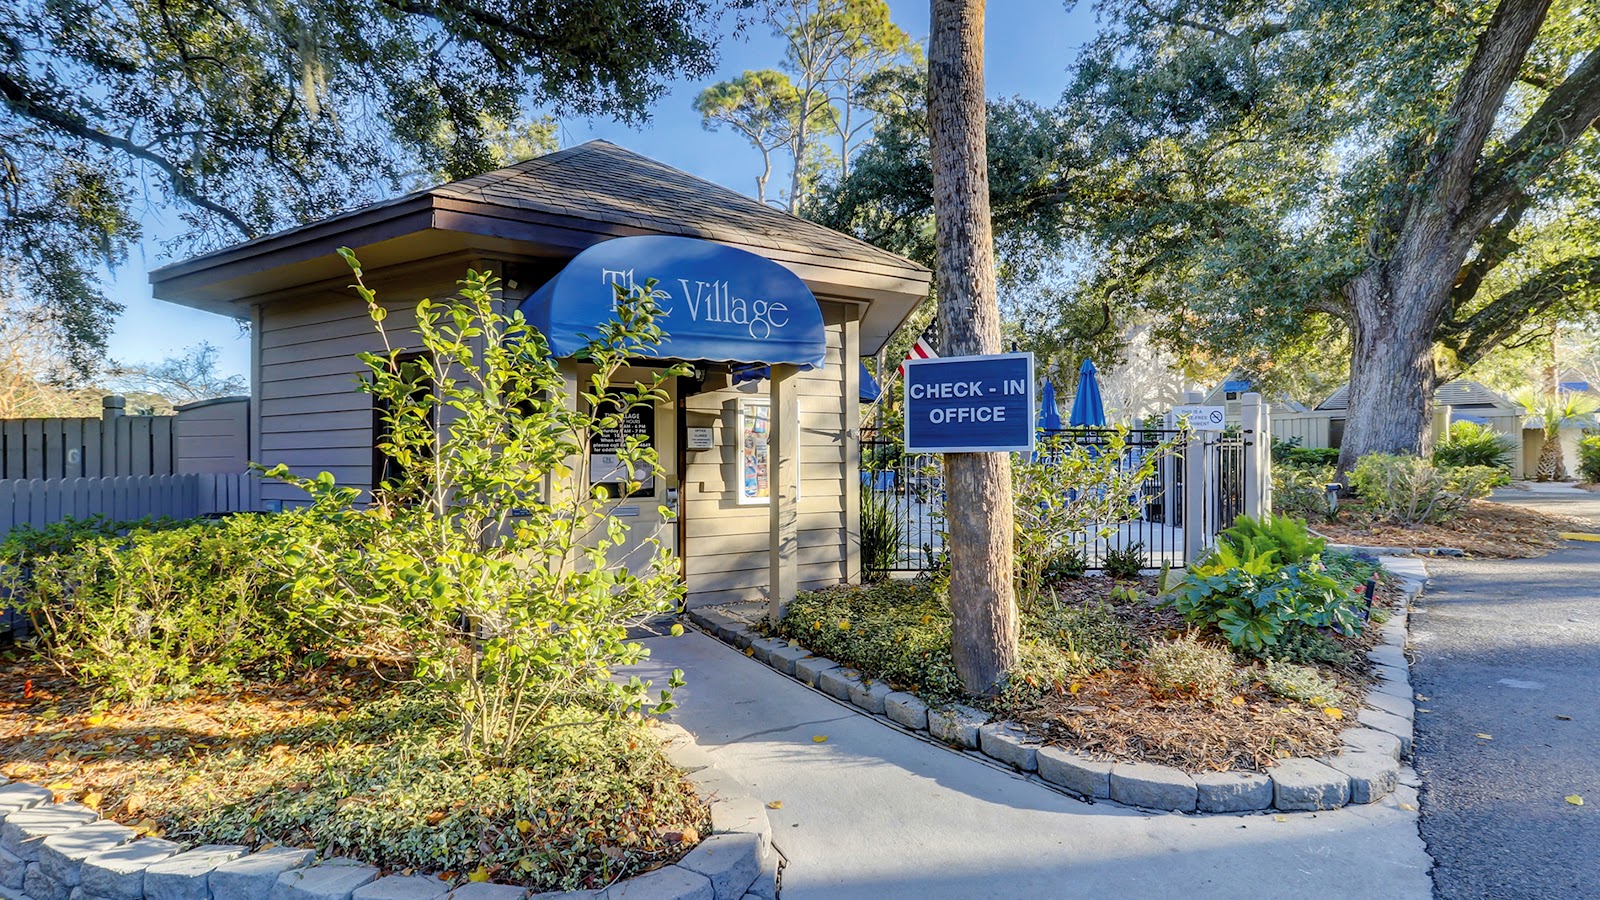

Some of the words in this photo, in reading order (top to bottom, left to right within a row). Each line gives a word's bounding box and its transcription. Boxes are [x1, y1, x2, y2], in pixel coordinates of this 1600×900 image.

[602, 267, 673, 316] The
[677, 278, 789, 339] Village
[910, 381, 983, 399] CHECK
[1003, 379, 1025, 396] IN
[929, 406, 1006, 424] OFFICE
